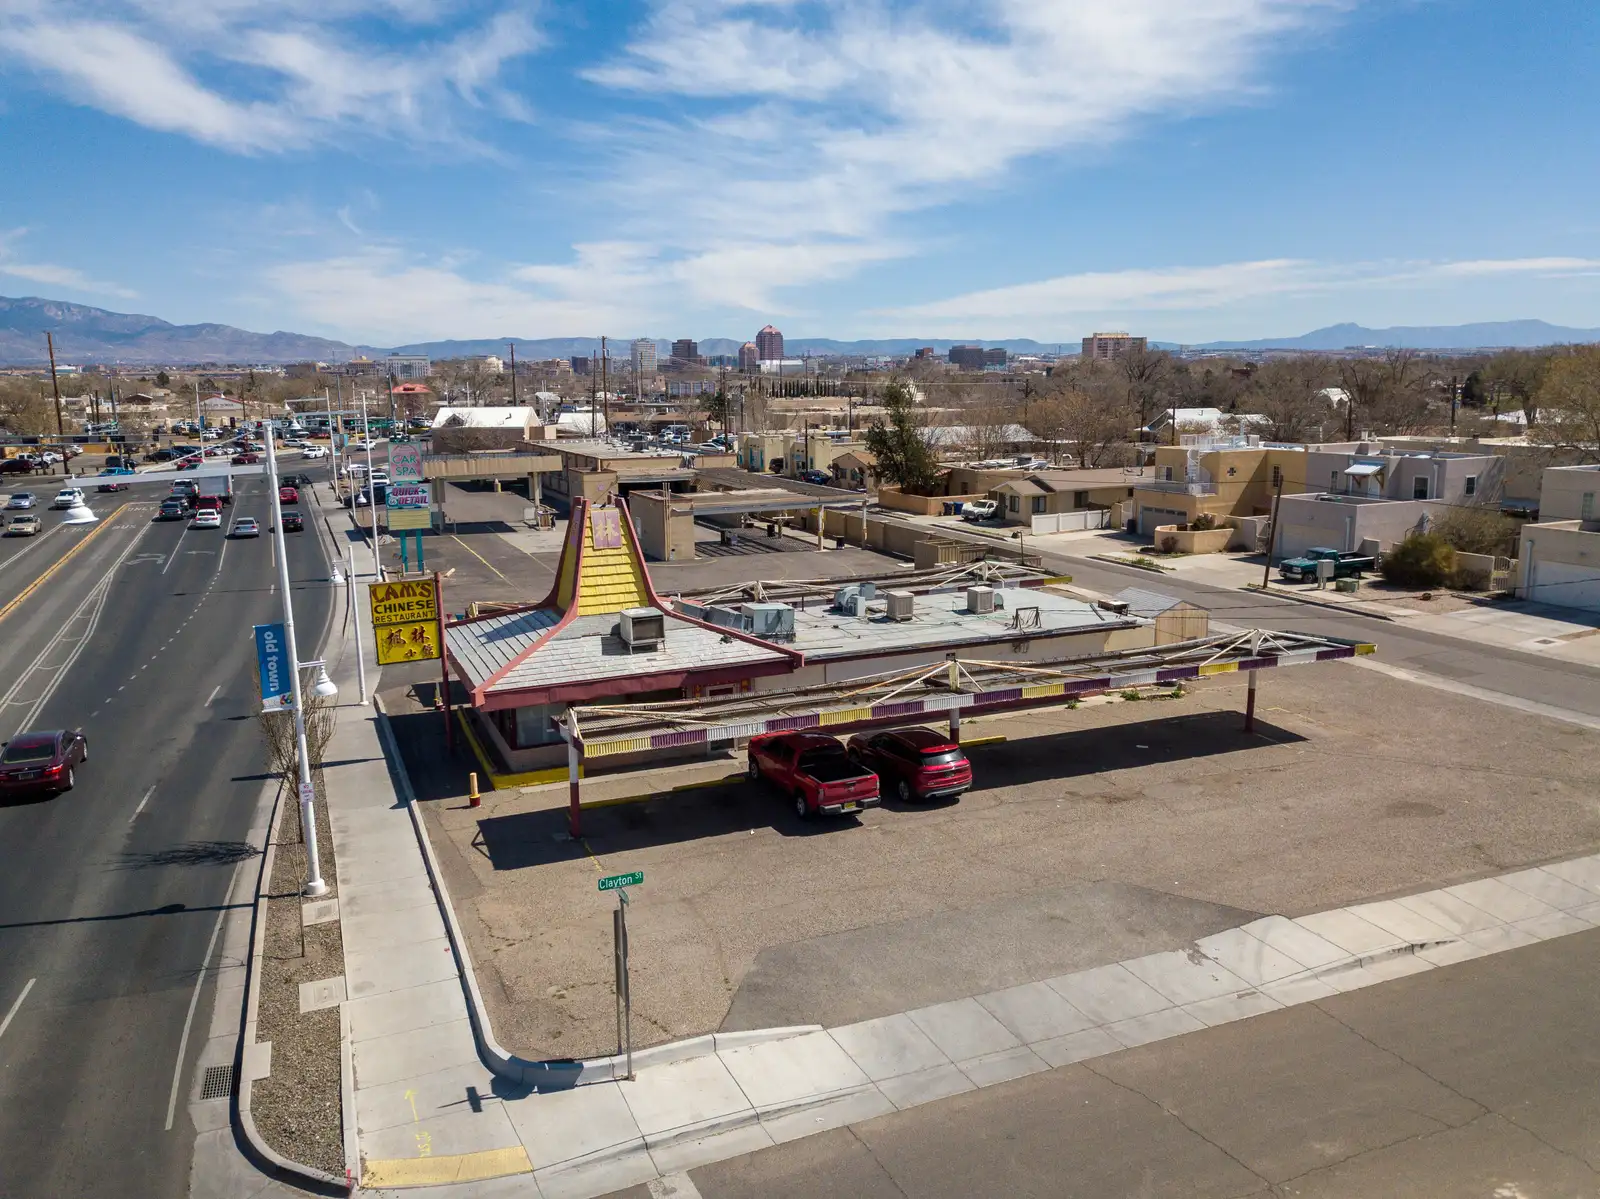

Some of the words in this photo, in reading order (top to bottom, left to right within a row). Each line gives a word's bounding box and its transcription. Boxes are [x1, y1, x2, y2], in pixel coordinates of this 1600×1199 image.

[392, 455, 417, 464] CAR
[395, 466, 417, 476] SPA
[392, 487, 420, 497] QUICK
[398, 496, 428, 505] DETAIL
[371, 582, 432, 603] LAM'S
[374, 600, 434, 614] CHINESE
[375, 610, 435, 623] RESTAURANT
[264, 631, 278, 653] old
[267, 655, 280, 692] town
[599, 876, 633, 889] Clayton
